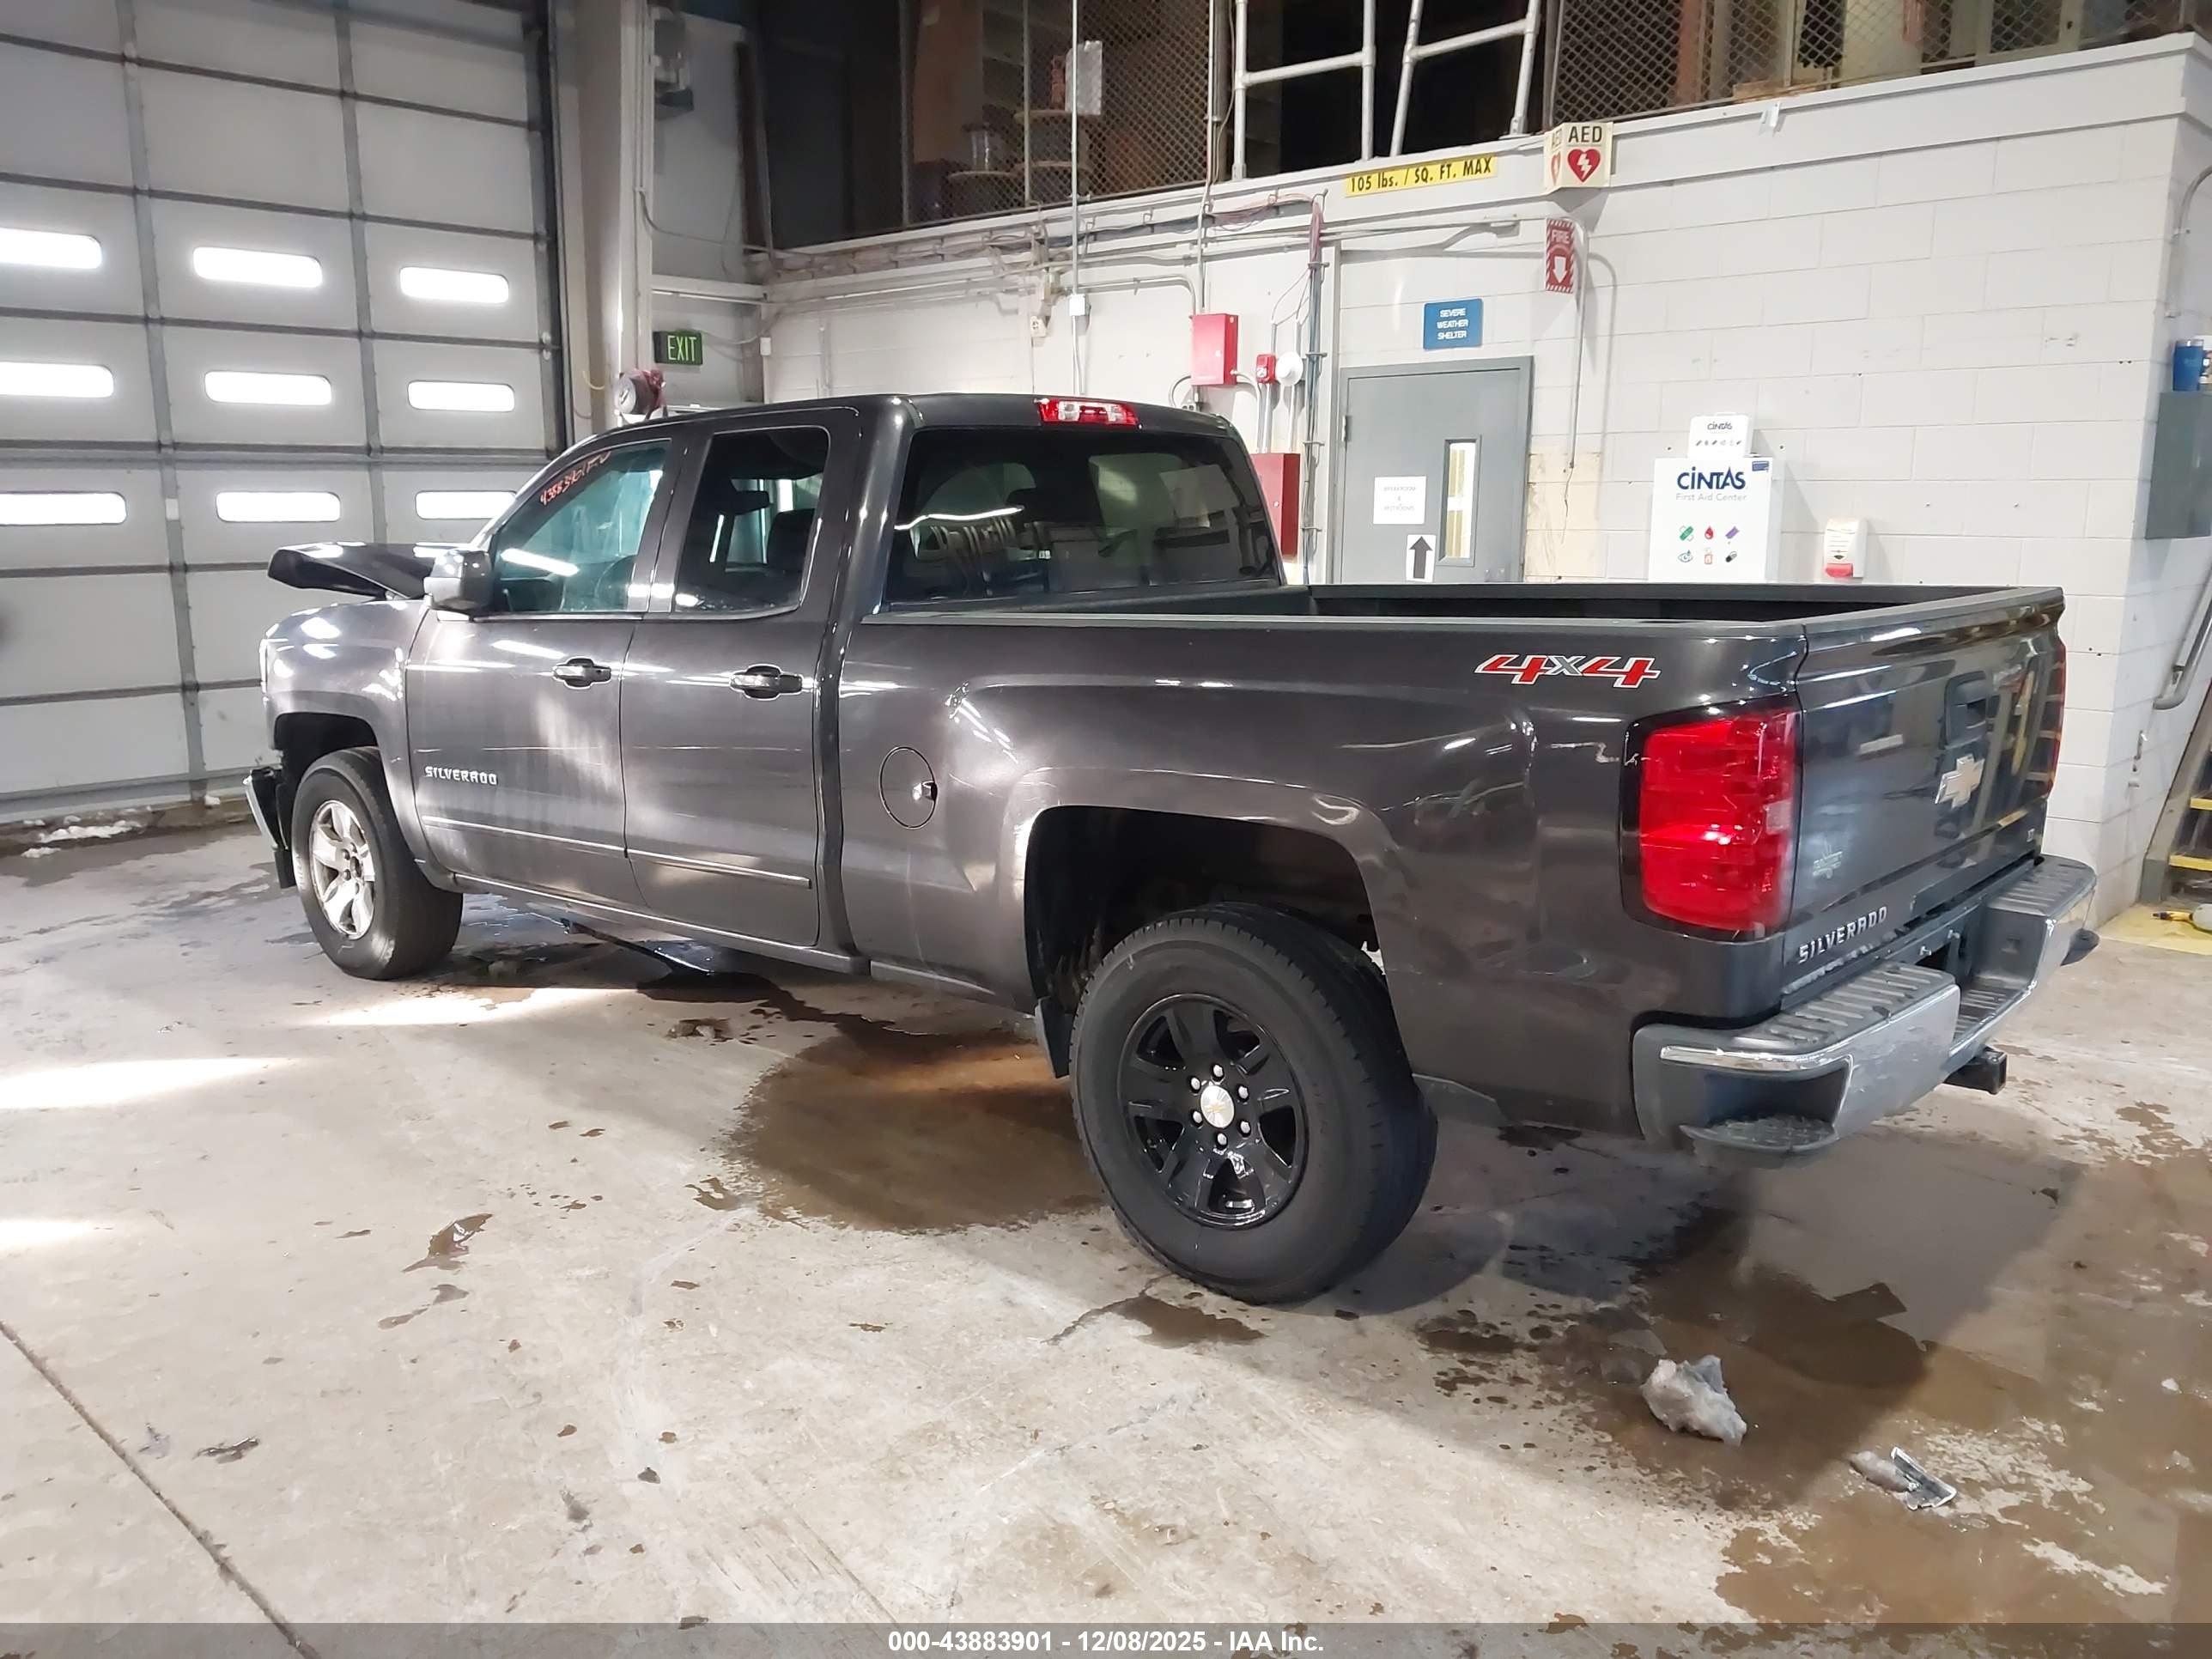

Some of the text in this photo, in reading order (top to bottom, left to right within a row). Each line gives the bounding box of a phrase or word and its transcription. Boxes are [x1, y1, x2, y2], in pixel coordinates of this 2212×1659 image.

[1568, 125, 1602, 143] AED
[1352, 175, 1372, 192] 105
[1377, 172, 1398, 189] lbs.
[1414, 166, 1433, 184] SQ.
[1439, 163, 1456, 179] FT.
[1462, 157, 1492, 177] MAX
[1552, 229, 1570, 244] FIRE
[1439, 307, 1467, 318] SEVERE
[1437, 319, 1469, 330] WEATHER
[1437, 330, 1468, 340] SHELTER
[667, 335, 697, 362] EXIT
[1676, 493, 1747, 501] First Aid Center
[425, 766, 498, 785] SILVERADO
[1798, 906, 1887, 964] SILVERADO
